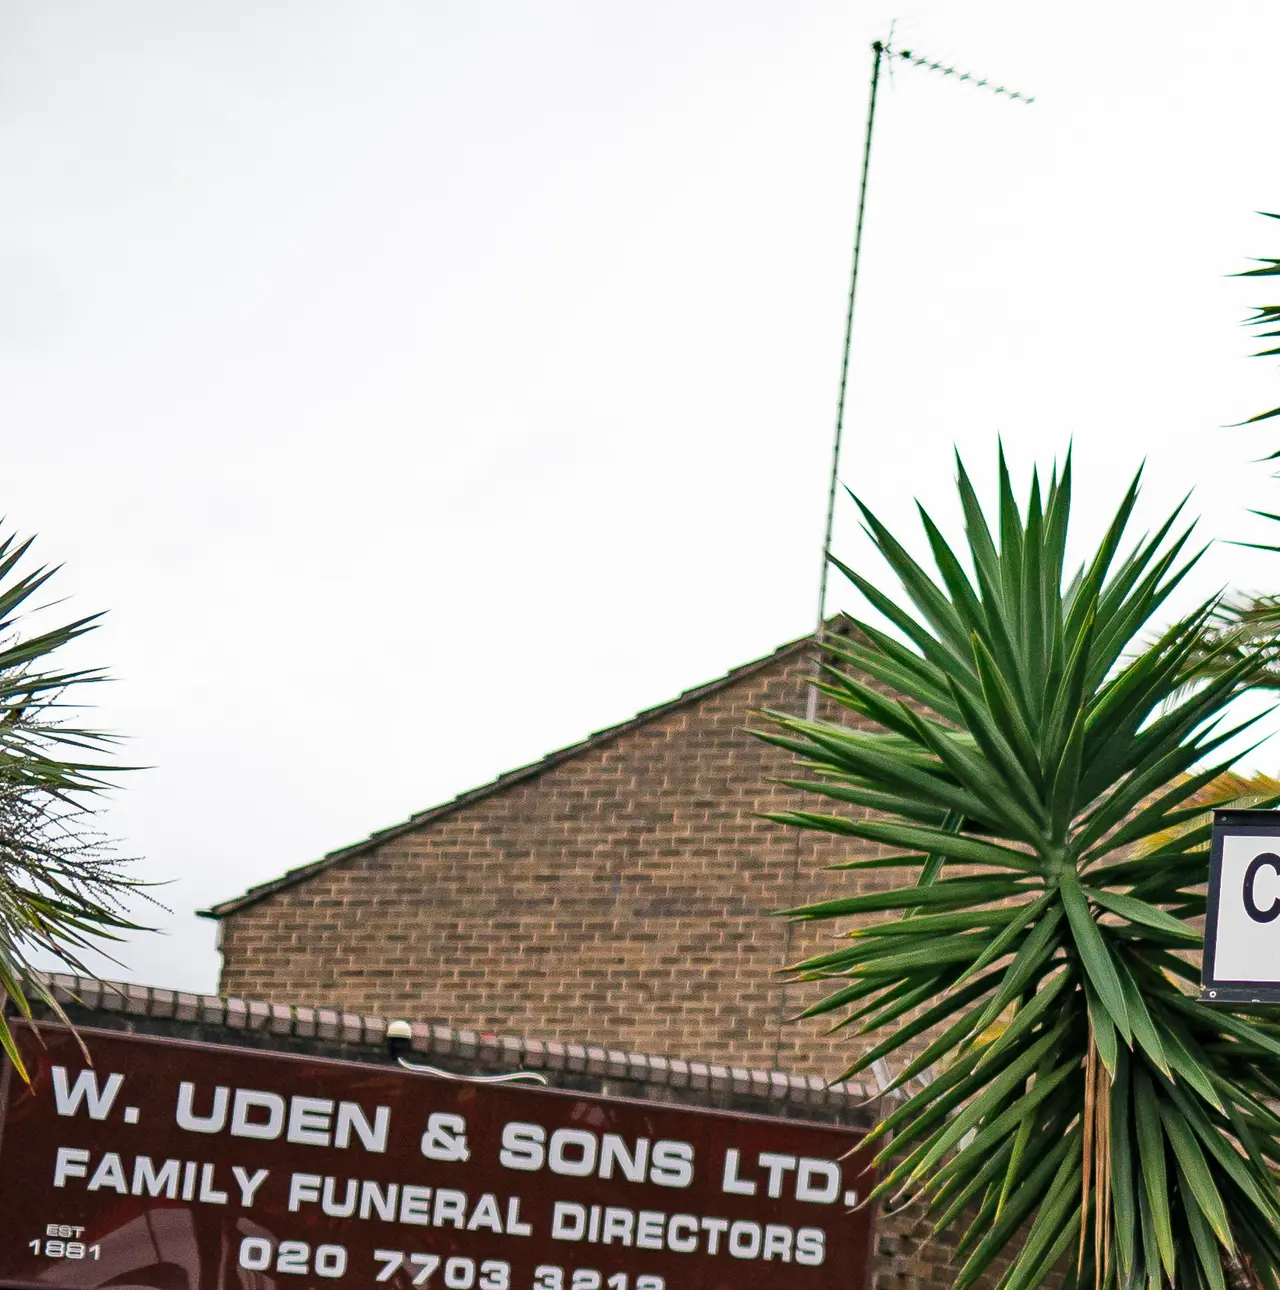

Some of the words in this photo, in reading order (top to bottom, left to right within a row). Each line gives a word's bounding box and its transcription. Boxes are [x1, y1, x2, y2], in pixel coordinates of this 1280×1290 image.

[52, 1066, 139, 1123] W.
[177, 1082, 389, 1152] UDEN
[422, 1113, 469, 1161] &
[500, 1123, 692, 1186] SONS
[723, 1149, 855, 1206] LTD.
[54, 1148, 268, 1206] FAMILY
[289, 1174, 530, 1235] FUNERAL
[552, 1202, 823, 1265] DIRECTORS
[28, 1239, 101, 1261] 1881
[46, 1223, 86, 1239] EST
[240, 1237, 346, 1277] 020
